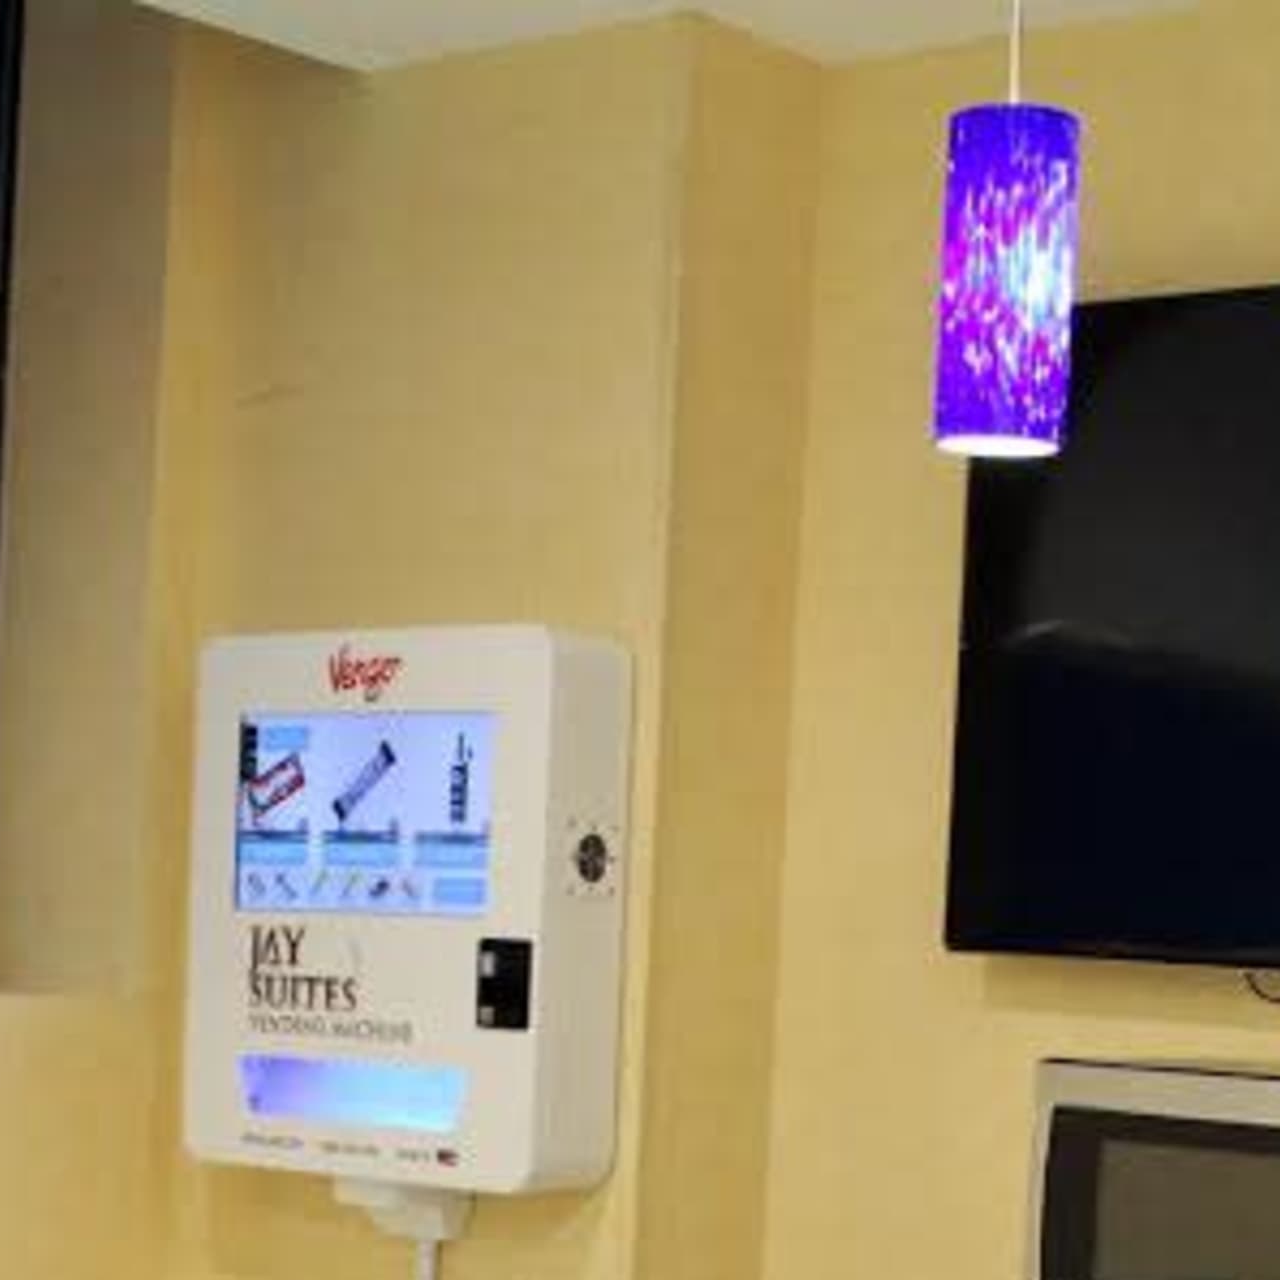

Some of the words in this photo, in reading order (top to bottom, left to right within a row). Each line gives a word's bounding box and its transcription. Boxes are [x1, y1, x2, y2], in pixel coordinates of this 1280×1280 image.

[328, 644, 402, 703] Vengo
[251, 925, 305, 971] JAY
[249, 973, 358, 1011] SUITES
